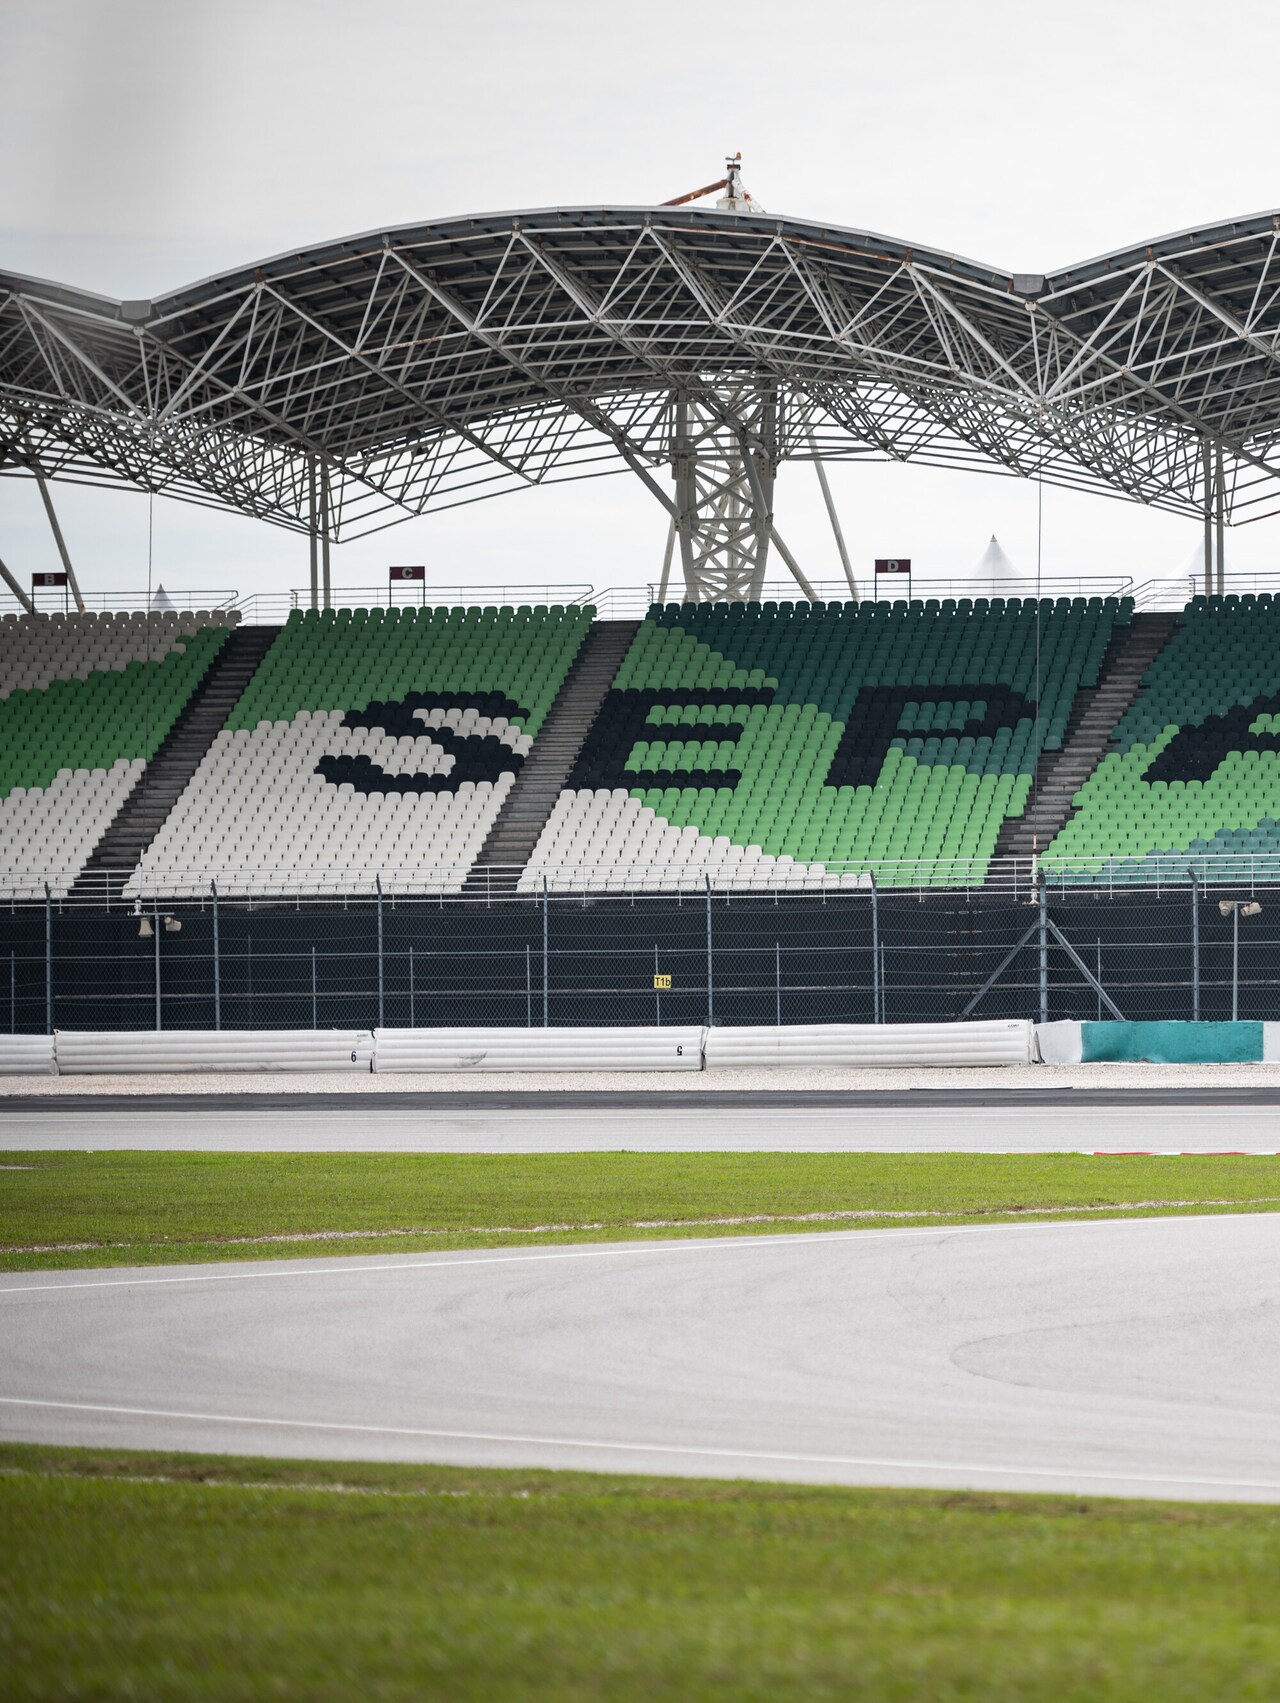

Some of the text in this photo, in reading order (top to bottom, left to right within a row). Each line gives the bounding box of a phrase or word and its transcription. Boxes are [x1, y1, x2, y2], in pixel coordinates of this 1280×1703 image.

[887, 560, 899, 572] D
[402, 567, 413, 579] C
[44, 574, 55, 585] B
[655, 977, 671, 987] T1b
